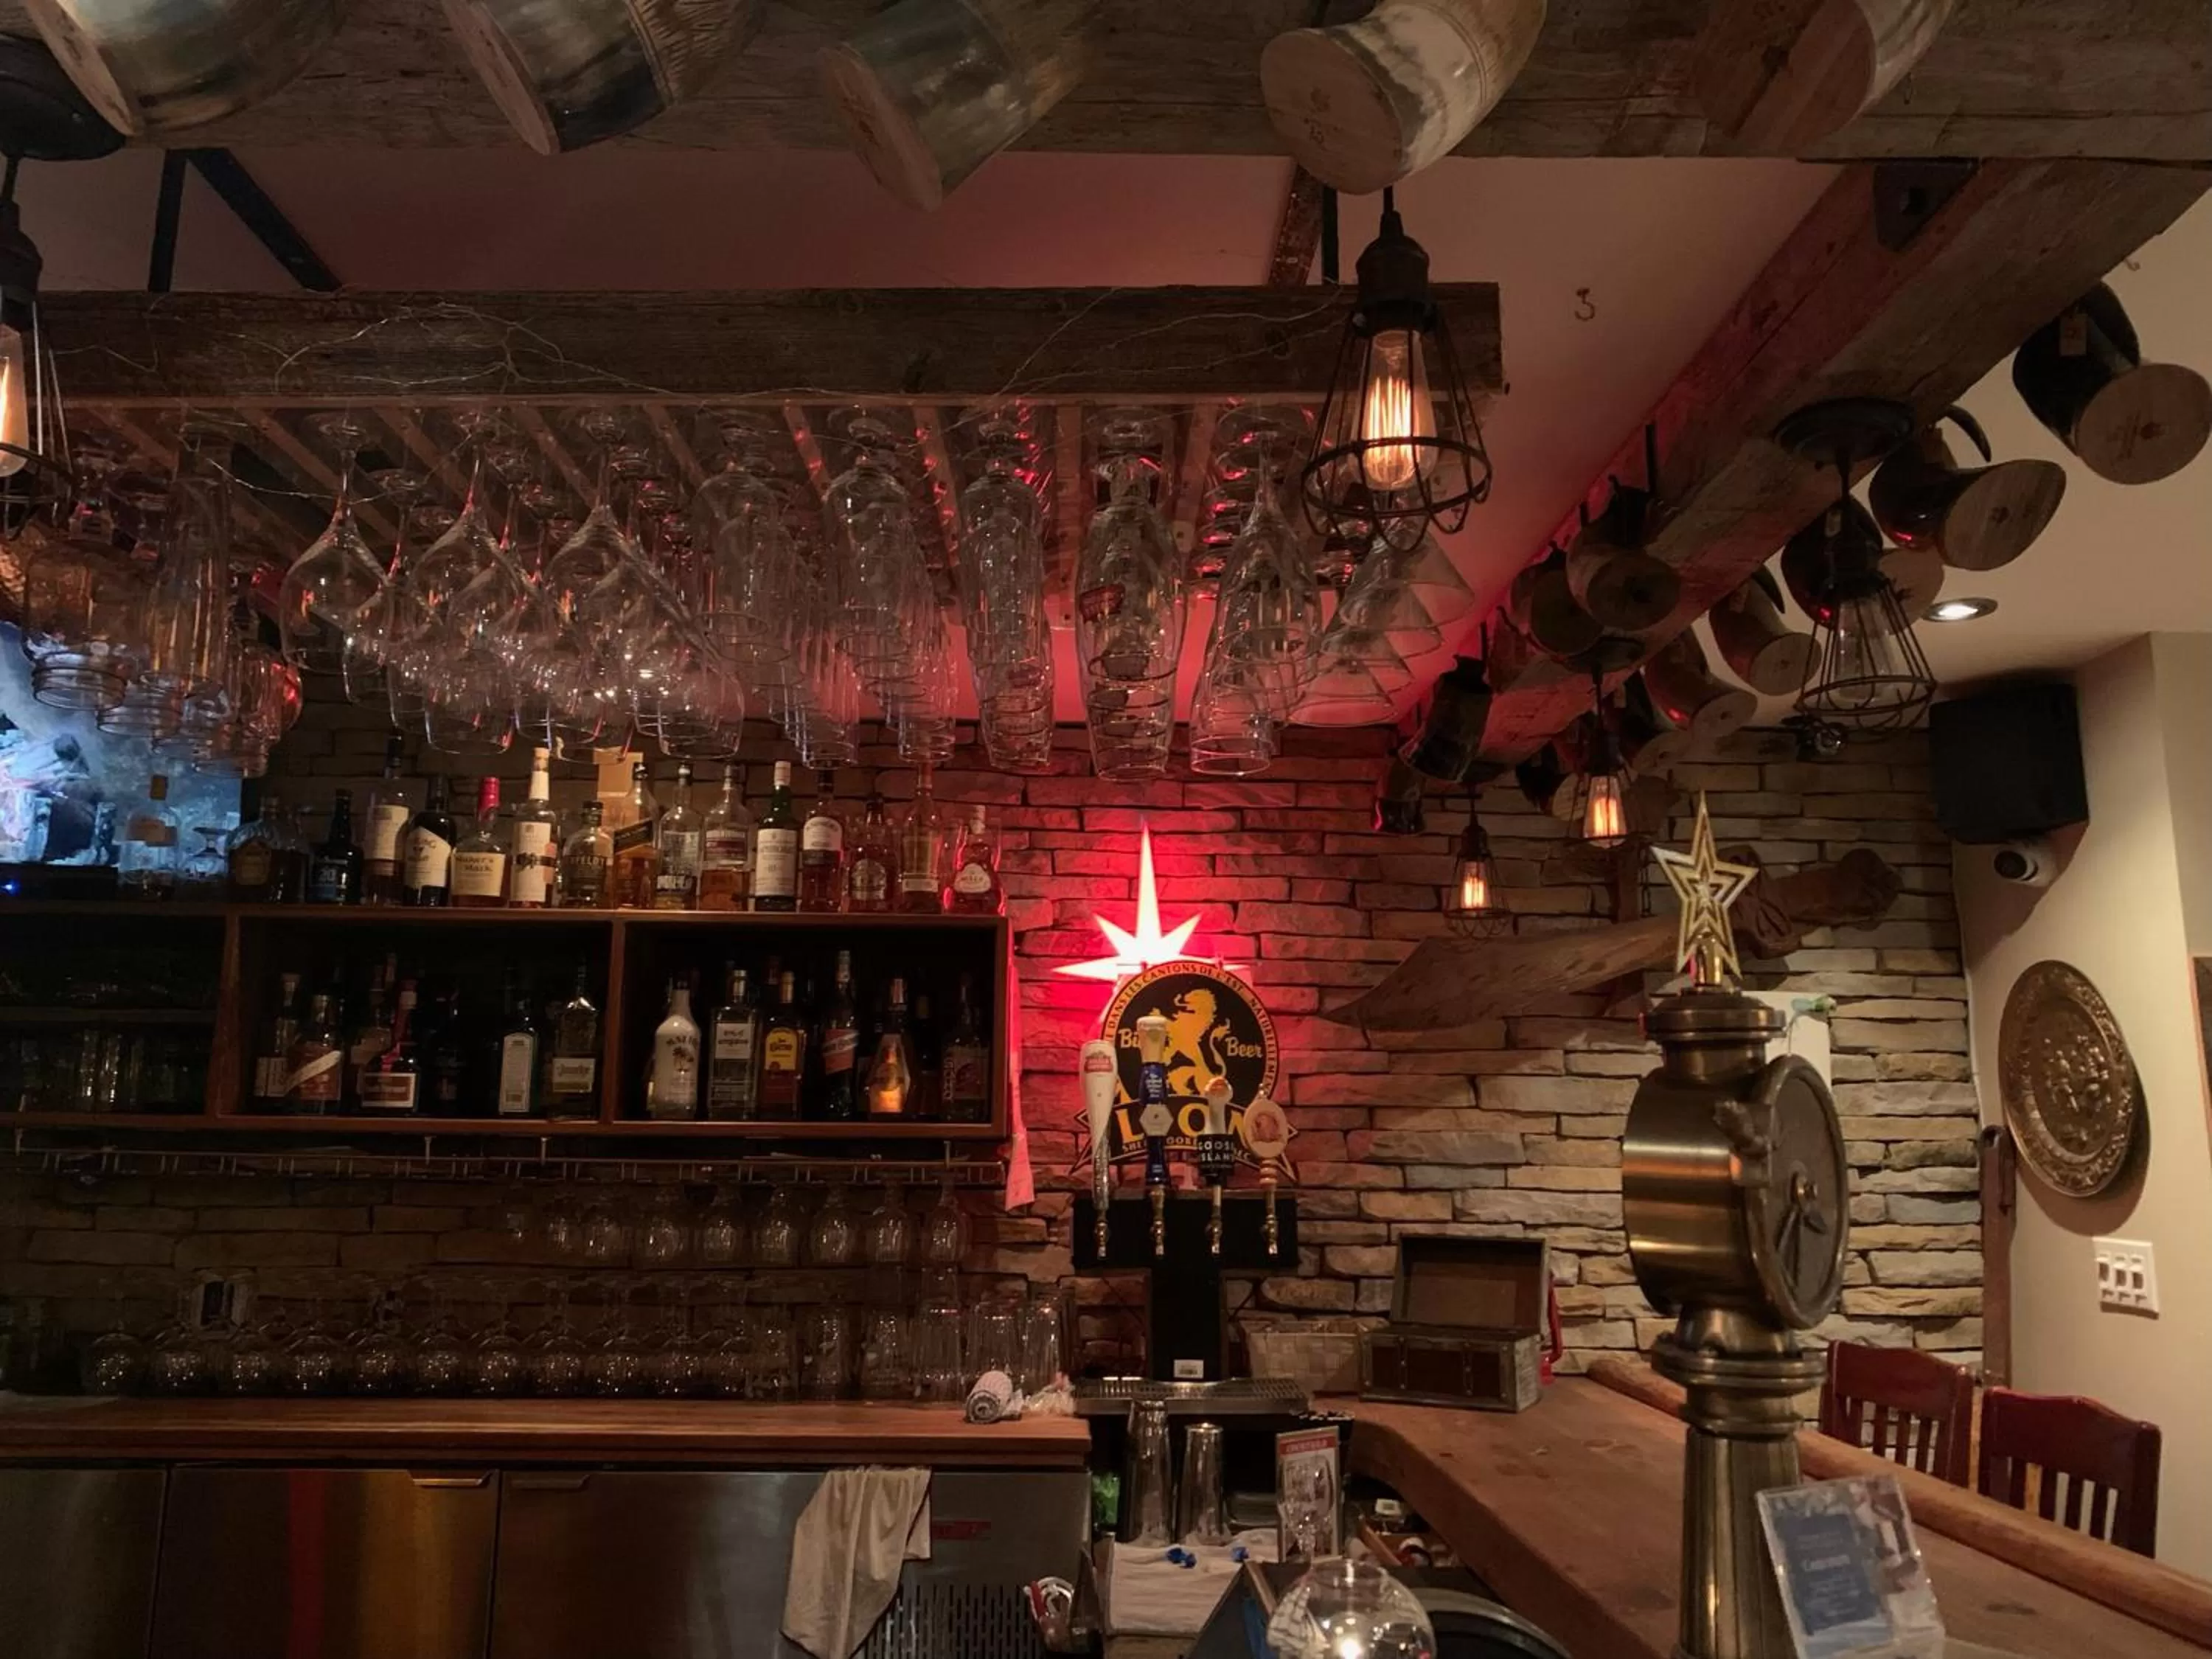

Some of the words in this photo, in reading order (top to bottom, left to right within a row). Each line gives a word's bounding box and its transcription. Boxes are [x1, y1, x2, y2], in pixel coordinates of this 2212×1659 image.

[1142, 964, 1197, 983] CANTONS
[1225, 1036, 1263, 1058] Beer
[1115, 1102, 1251, 1150] LON
